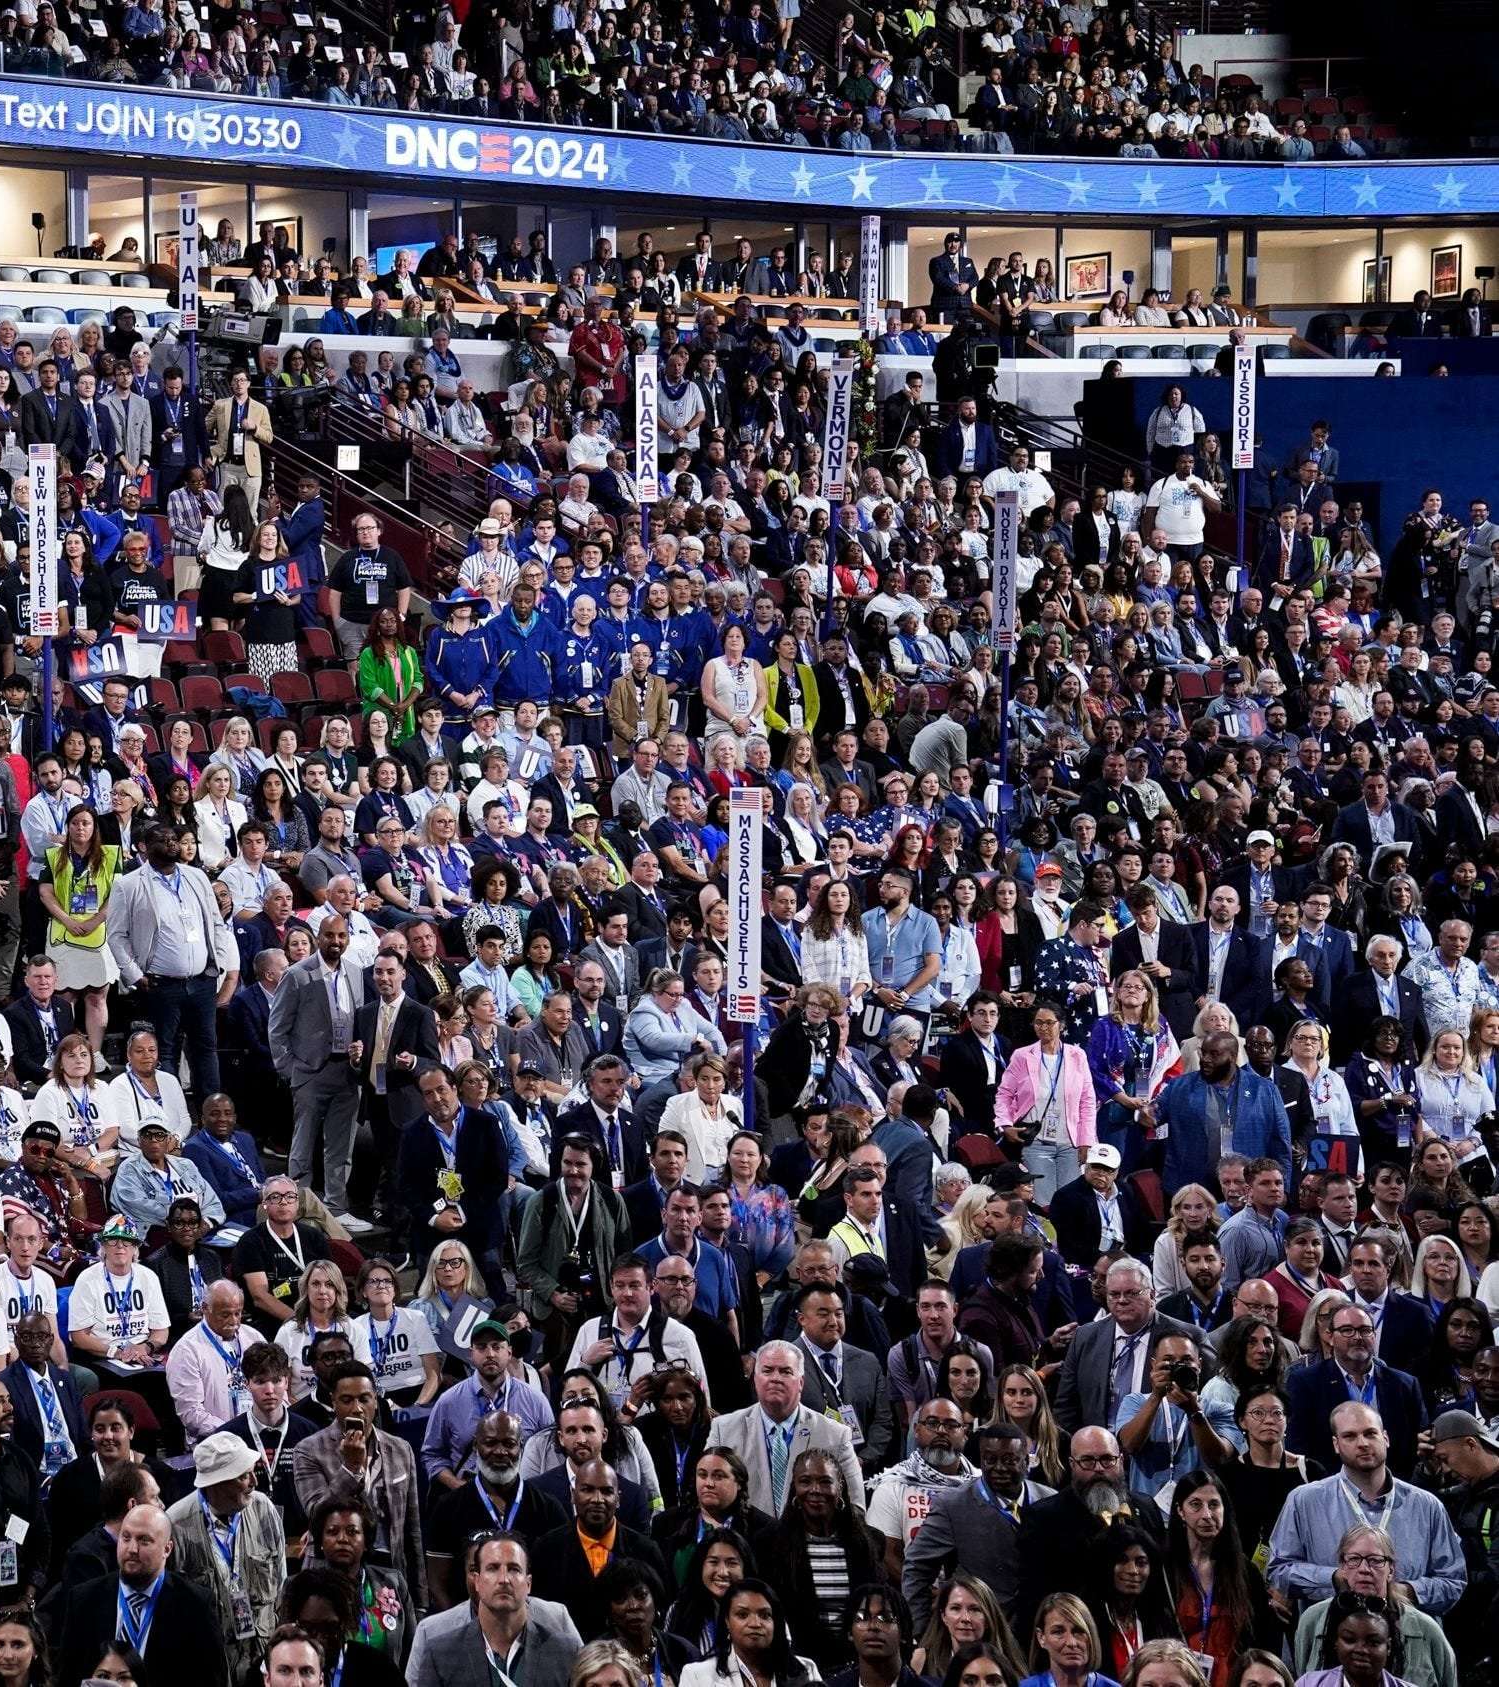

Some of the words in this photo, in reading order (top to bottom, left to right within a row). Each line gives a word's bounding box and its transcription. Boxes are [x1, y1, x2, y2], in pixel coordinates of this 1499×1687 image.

[76, 101, 155, 138] JOIN
[165, 110, 196, 141] to
[203, 113, 302, 149] 30330
[512, 136, 609, 181] 2024
[182, 208, 196, 311] UTAH
[861, 229, 869, 315] HAWAII
[870, 229, 879, 315] HAWAII
[639, 372, 655, 480] ALASKA
[827, 375, 849, 481] VERMONT
[1236, 358, 1252, 452] MISSOURI
[35, 465, 46, 500] NEW
[36, 505, 47, 608] HAMPSHIRE
[1000, 507, 1011, 560] NORTH
[261, 561, 303, 595] USA
[998, 566, 1009, 628] DAKOTA
[144, 604, 190, 634] USA
[71, 642, 121, 678] USA
[1224, 713, 1267, 738] USA
[737, 814, 752, 990] MASSACHUSETTS
[729, 993, 737, 1019] DNC
[66, 1102, 99, 1120] OO
[1307, 1139, 1348, 1174] SA
